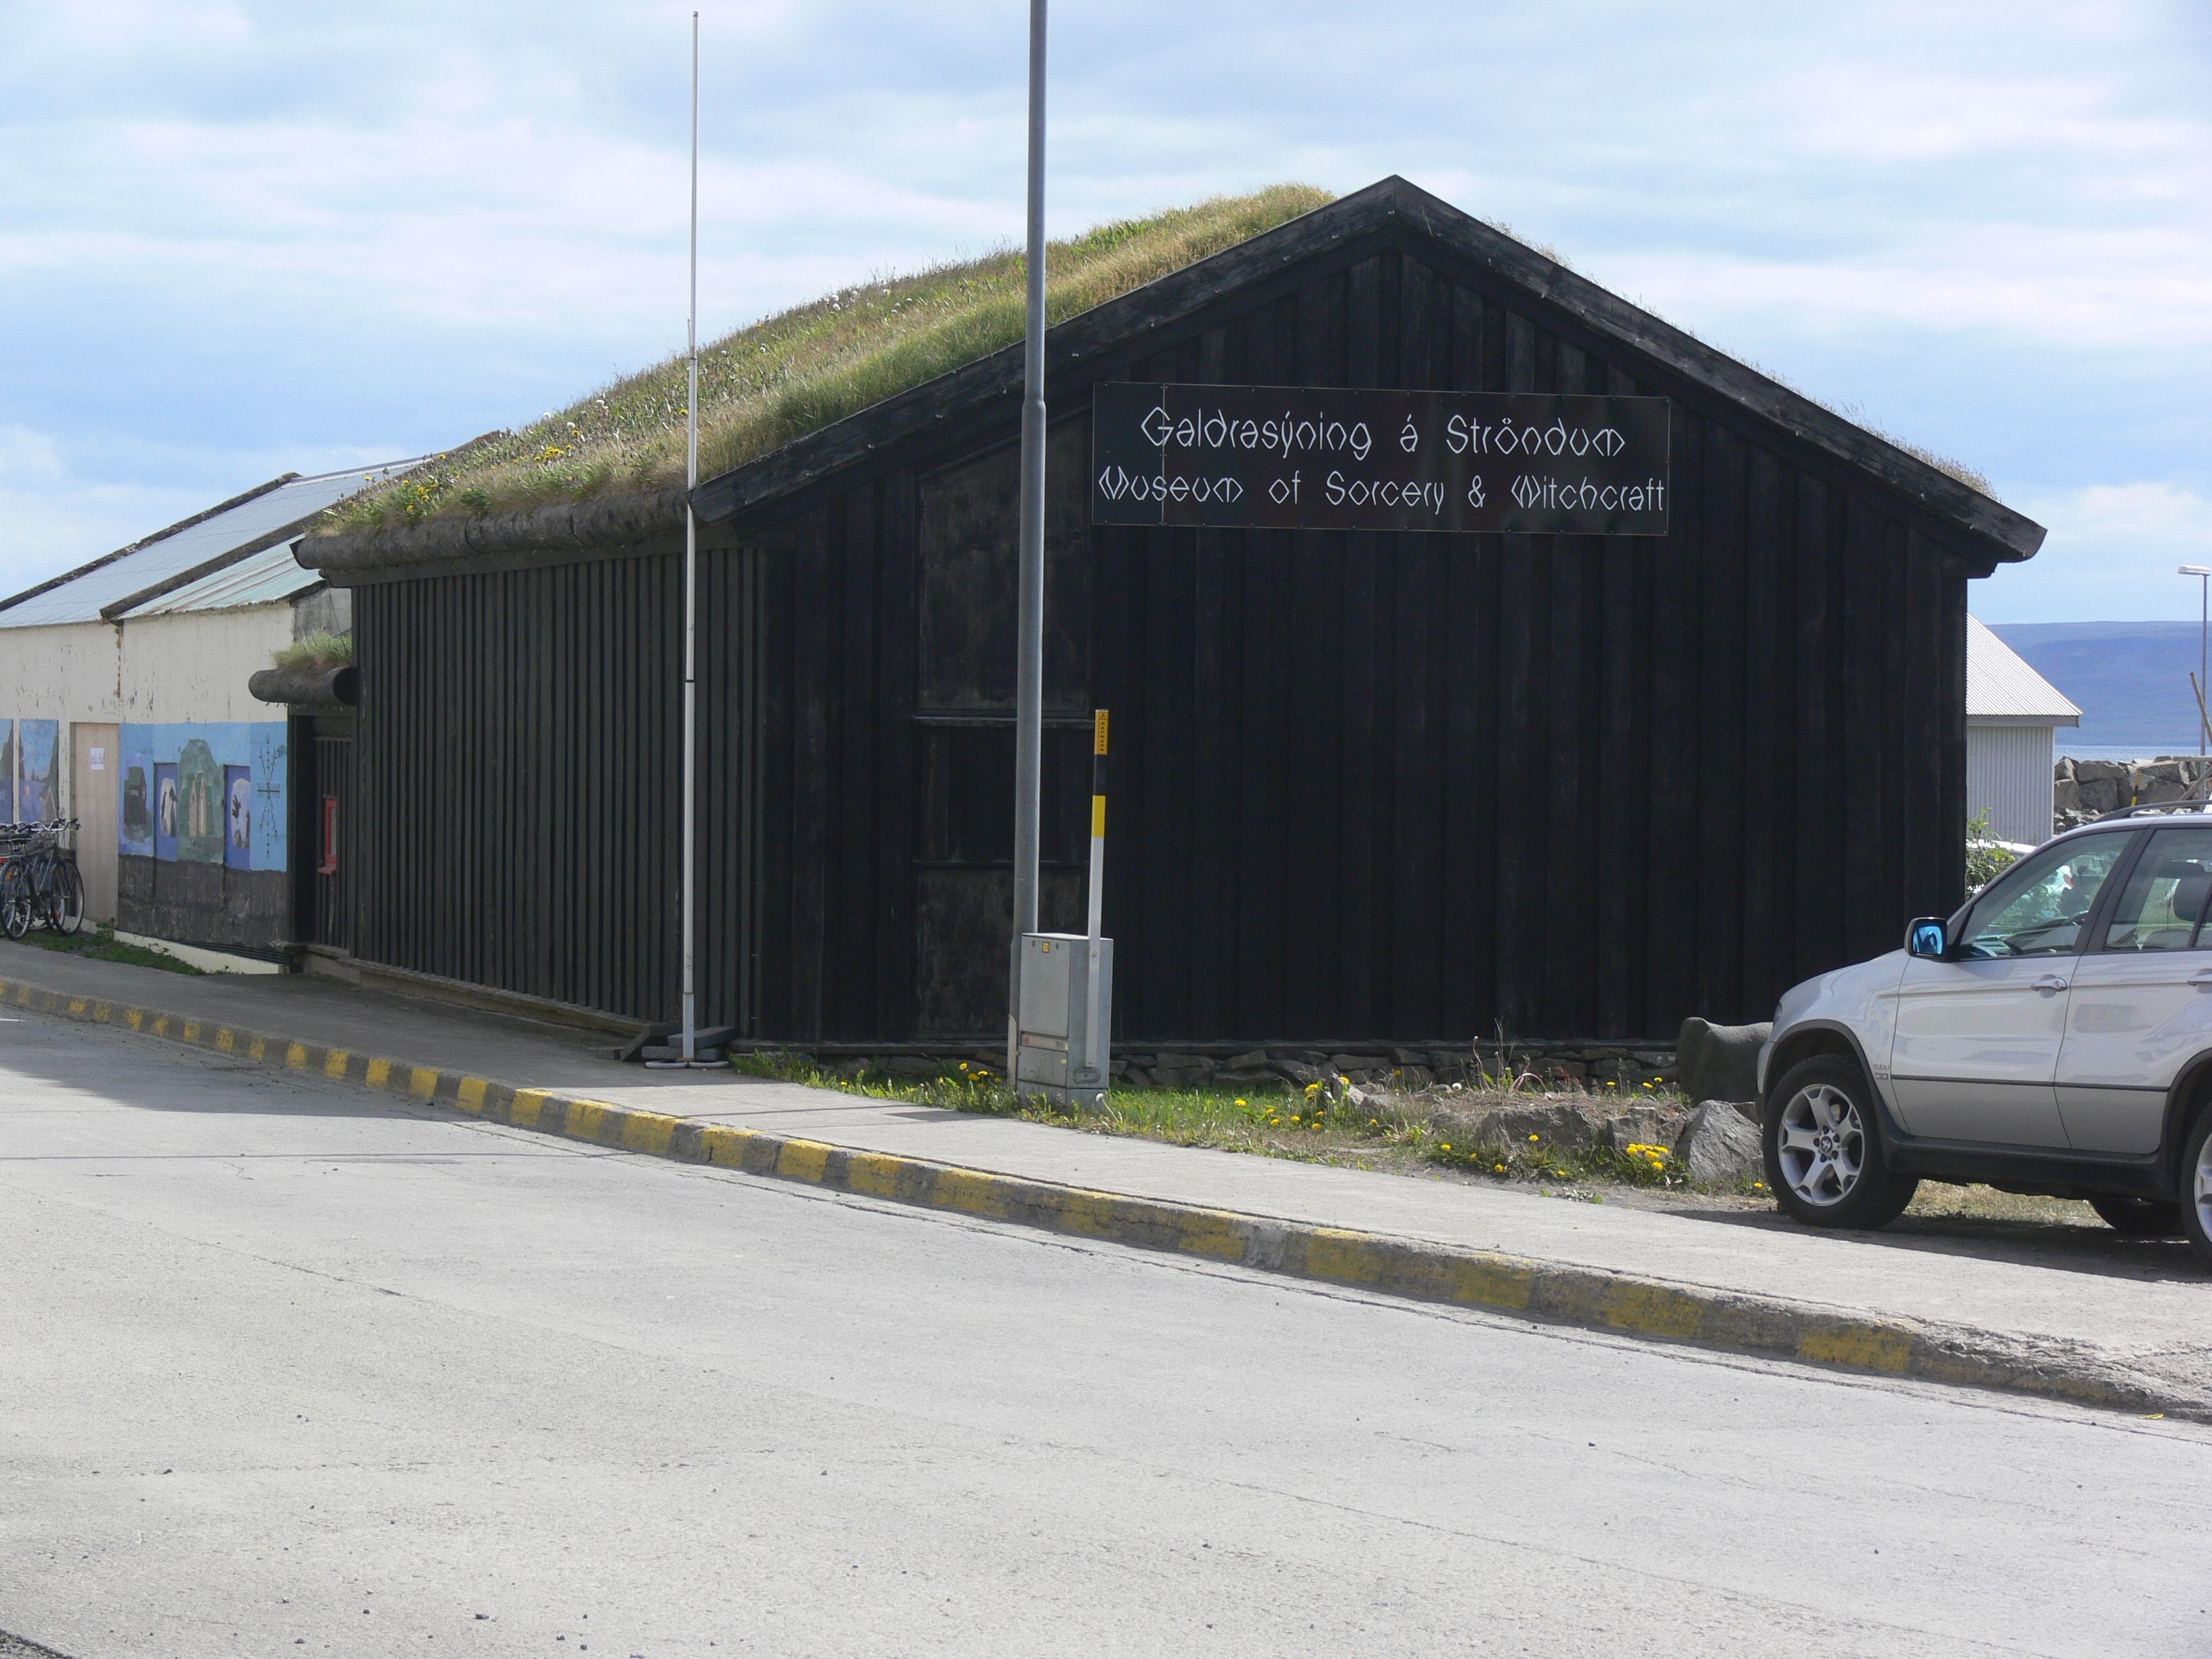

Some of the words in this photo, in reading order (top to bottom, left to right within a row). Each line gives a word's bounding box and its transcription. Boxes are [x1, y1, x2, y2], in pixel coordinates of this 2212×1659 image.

[1141, 407, 1372, 460] Galdrasýning
[1399, 414, 1418, 452] á
[1446, 415, 1625, 456] Ströndum
[1098, 466, 1244, 502] Museum
[1268, 470, 1301, 504] of
[1326, 470, 1444, 515] Sorcery
[1468, 475, 1486, 508] &
[1511, 475, 1664, 511] Witchcraft
